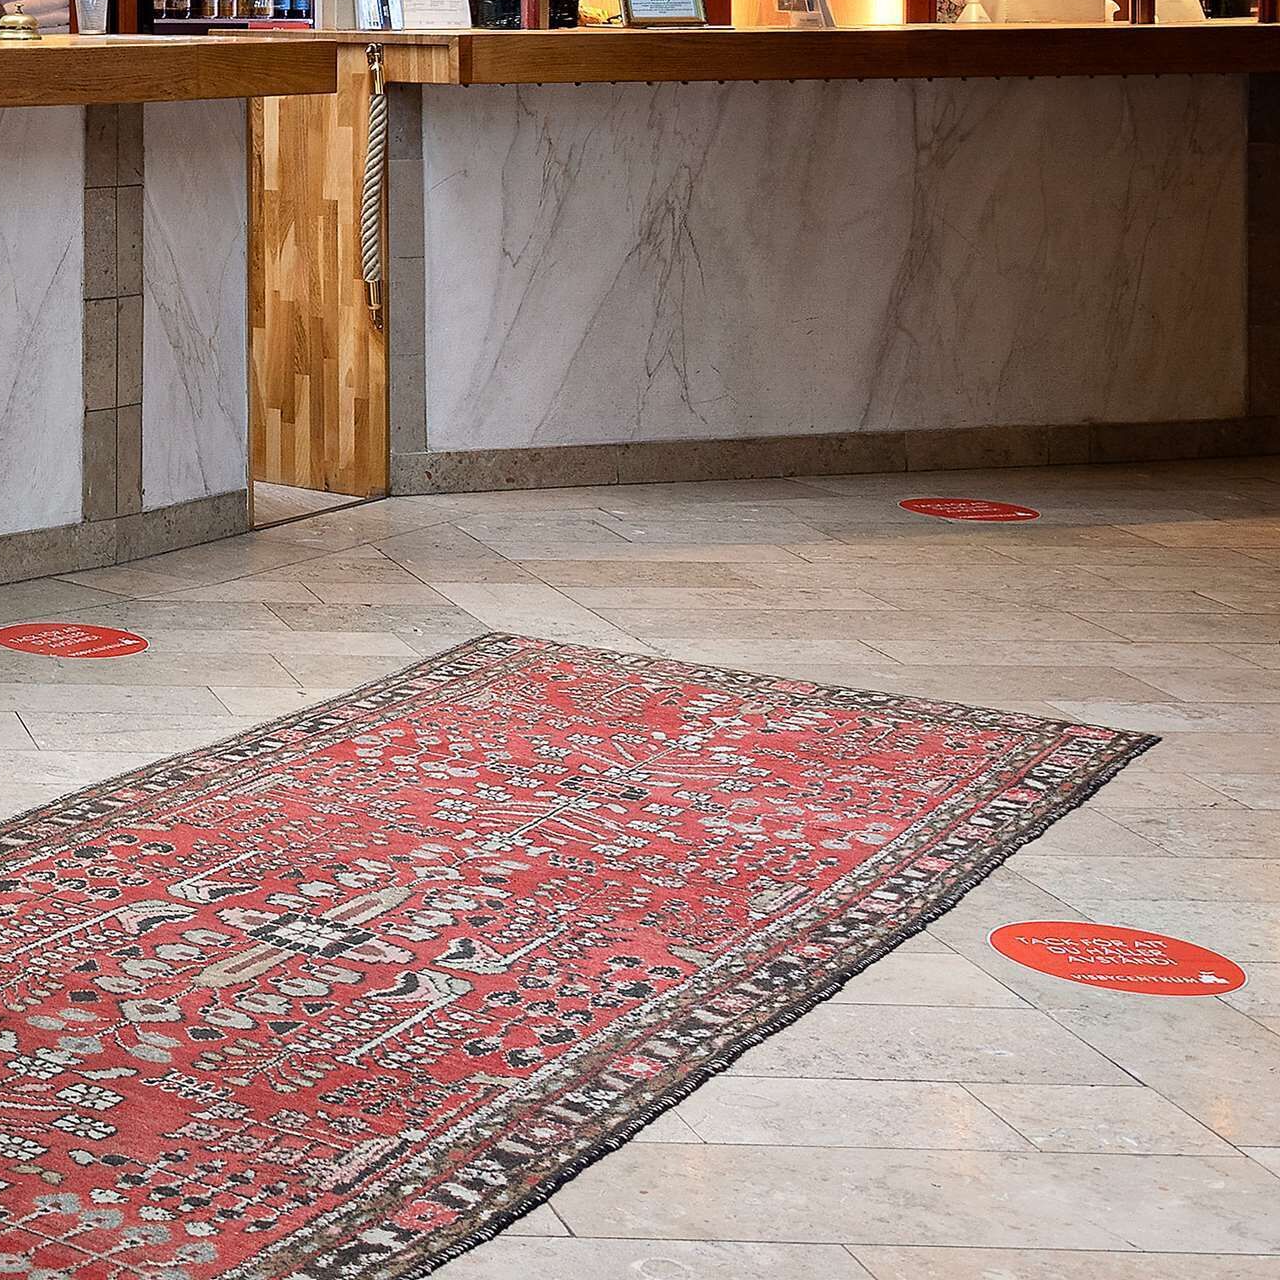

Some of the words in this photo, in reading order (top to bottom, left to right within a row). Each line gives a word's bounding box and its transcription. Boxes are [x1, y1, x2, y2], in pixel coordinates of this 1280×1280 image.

[1015, 936, 1079, 947] TACK
[1132, 939, 1168, 949] ATT
[1046, 946, 1081, 955] DU
